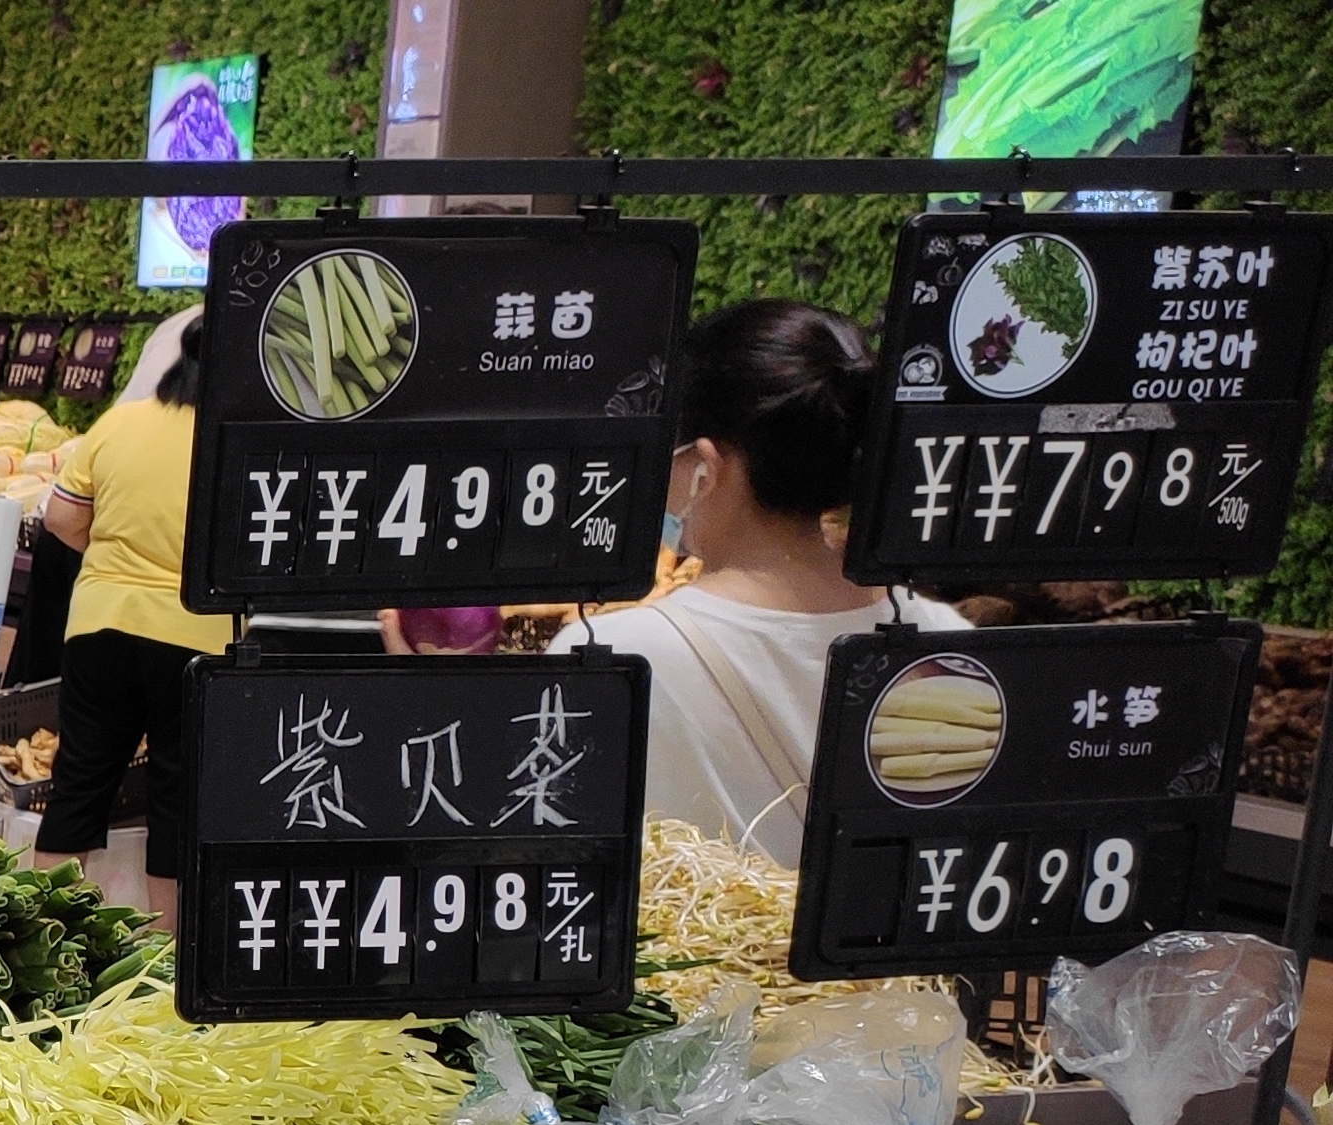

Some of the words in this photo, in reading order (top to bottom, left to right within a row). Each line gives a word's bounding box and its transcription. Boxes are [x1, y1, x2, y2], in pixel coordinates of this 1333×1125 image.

[1151, 245, 1274, 290] 紫苏叶
[493, 290, 594, 340] 蒜苗
[1159, 300, 1184, 321] ZI
[1186, 300, 1217, 321] SU
[1222, 299, 1248, 320] YE
[478, 350, 533, 373] Suan
[542, 351, 595, 372] miao
[1135, 328, 1257, 372] 枸杞叶
[1132, 378, 1183, 399] GOU
[1187, 378, 1214, 403] QI
[1219, 377, 1244, 398] YE
[1072, 685, 1162, 729] 水笋
[1068, 739, 1110, 760] Shui
[1118, 740, 1152, 757] sun
